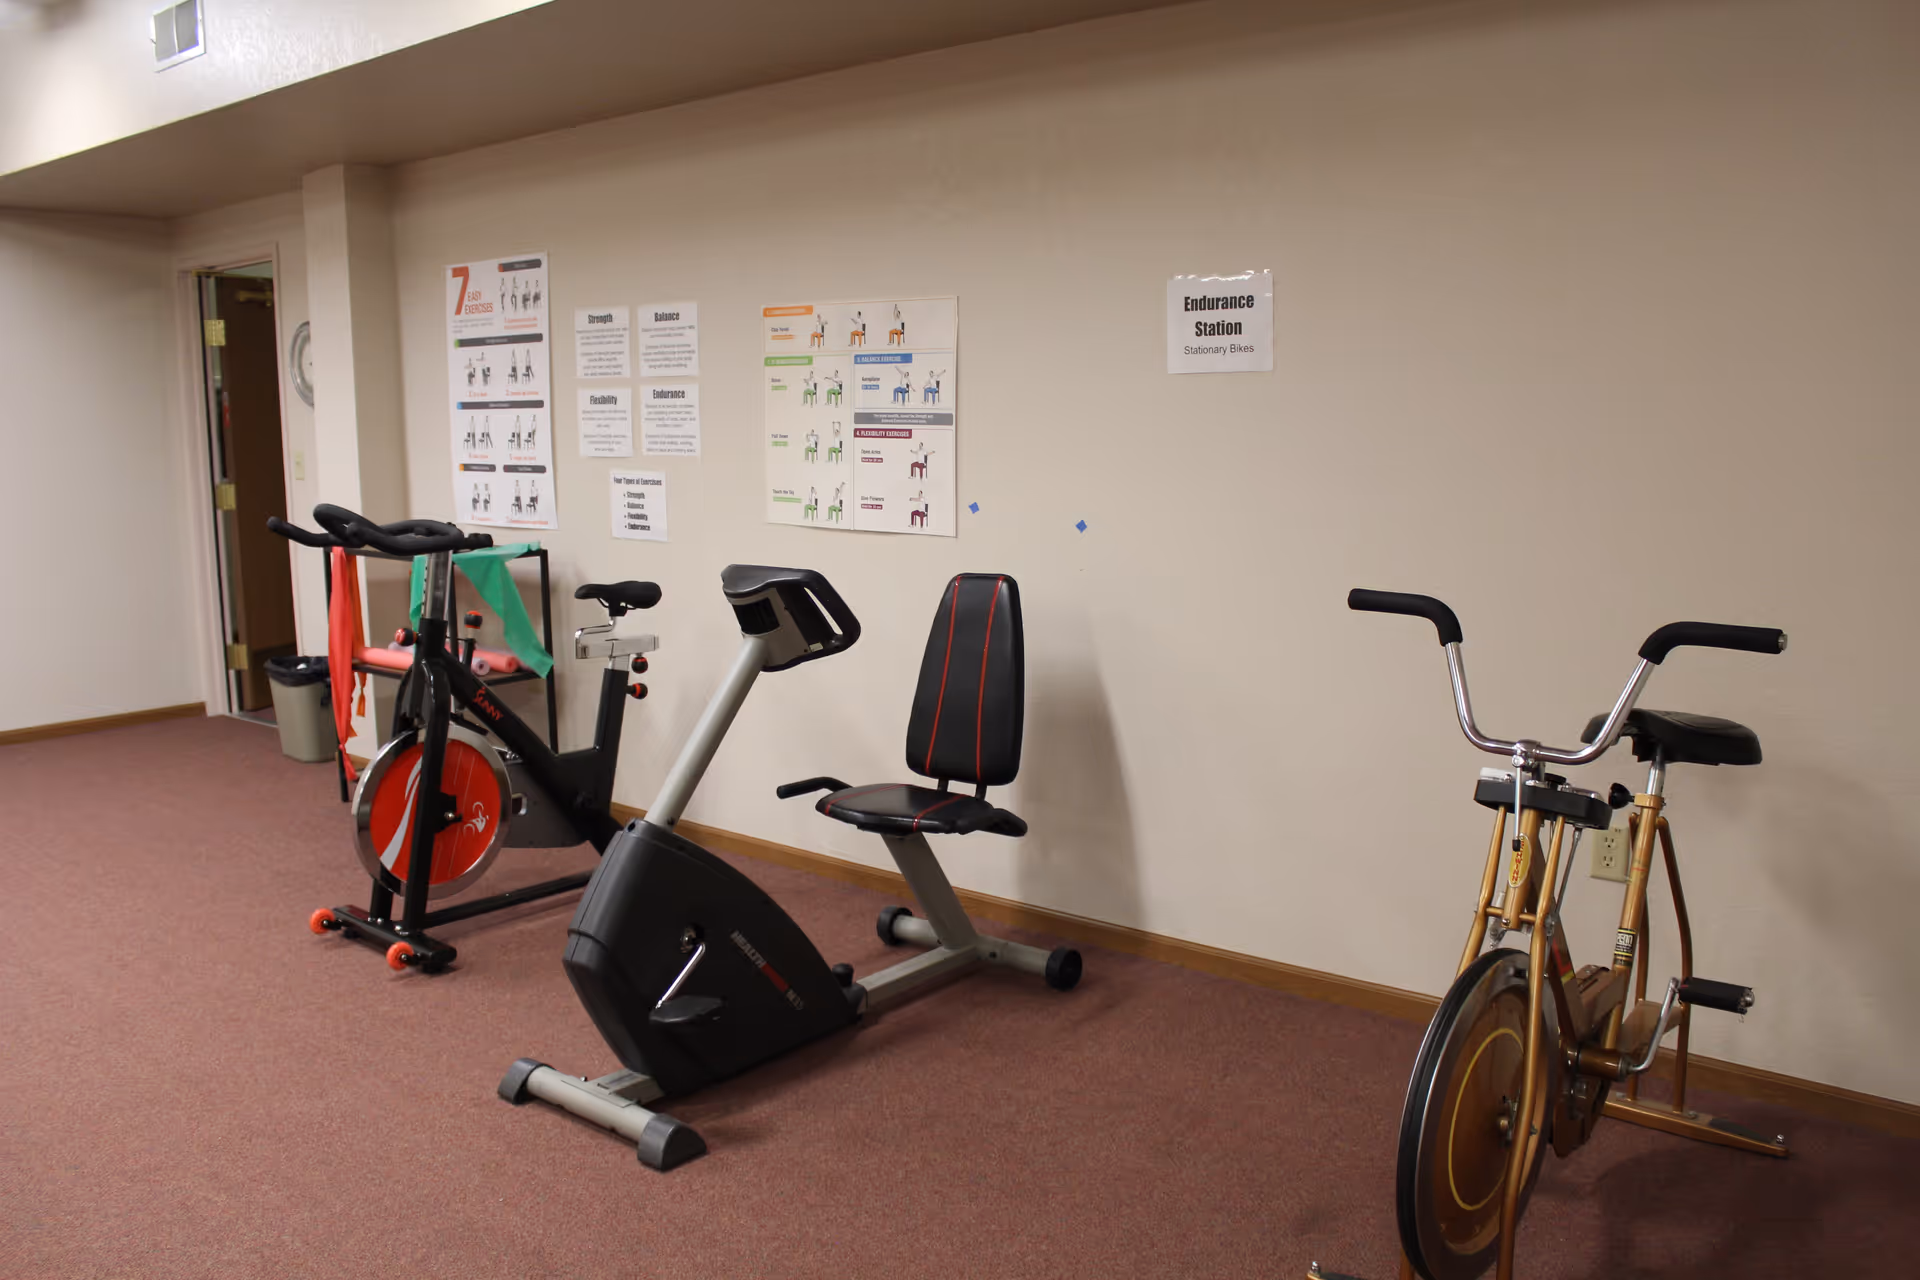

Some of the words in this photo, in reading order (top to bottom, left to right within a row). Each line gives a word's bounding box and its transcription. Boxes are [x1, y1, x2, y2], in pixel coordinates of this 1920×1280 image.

[452, 265, 469, 316] 7
[467, 289, 482, 302] EASY
[464, 302, 494, 315] EXERCISES
[1184, 294, 1255, 312] Endurance
[588, 313, 613, 324] Strength
[654, 311, 680, 322] Balance
[1195, 320, 1243, 337] Station
[1184, 345, 1228, 356] Stationary
[1230, 344, 1255, 354] Bikes
[652, 389, 686, 399] Endurance
[589, 395, 618, 405] Flexibility
[641, 478, 662, 486] Exercises
[628, 522, 651, 531] Endurance
